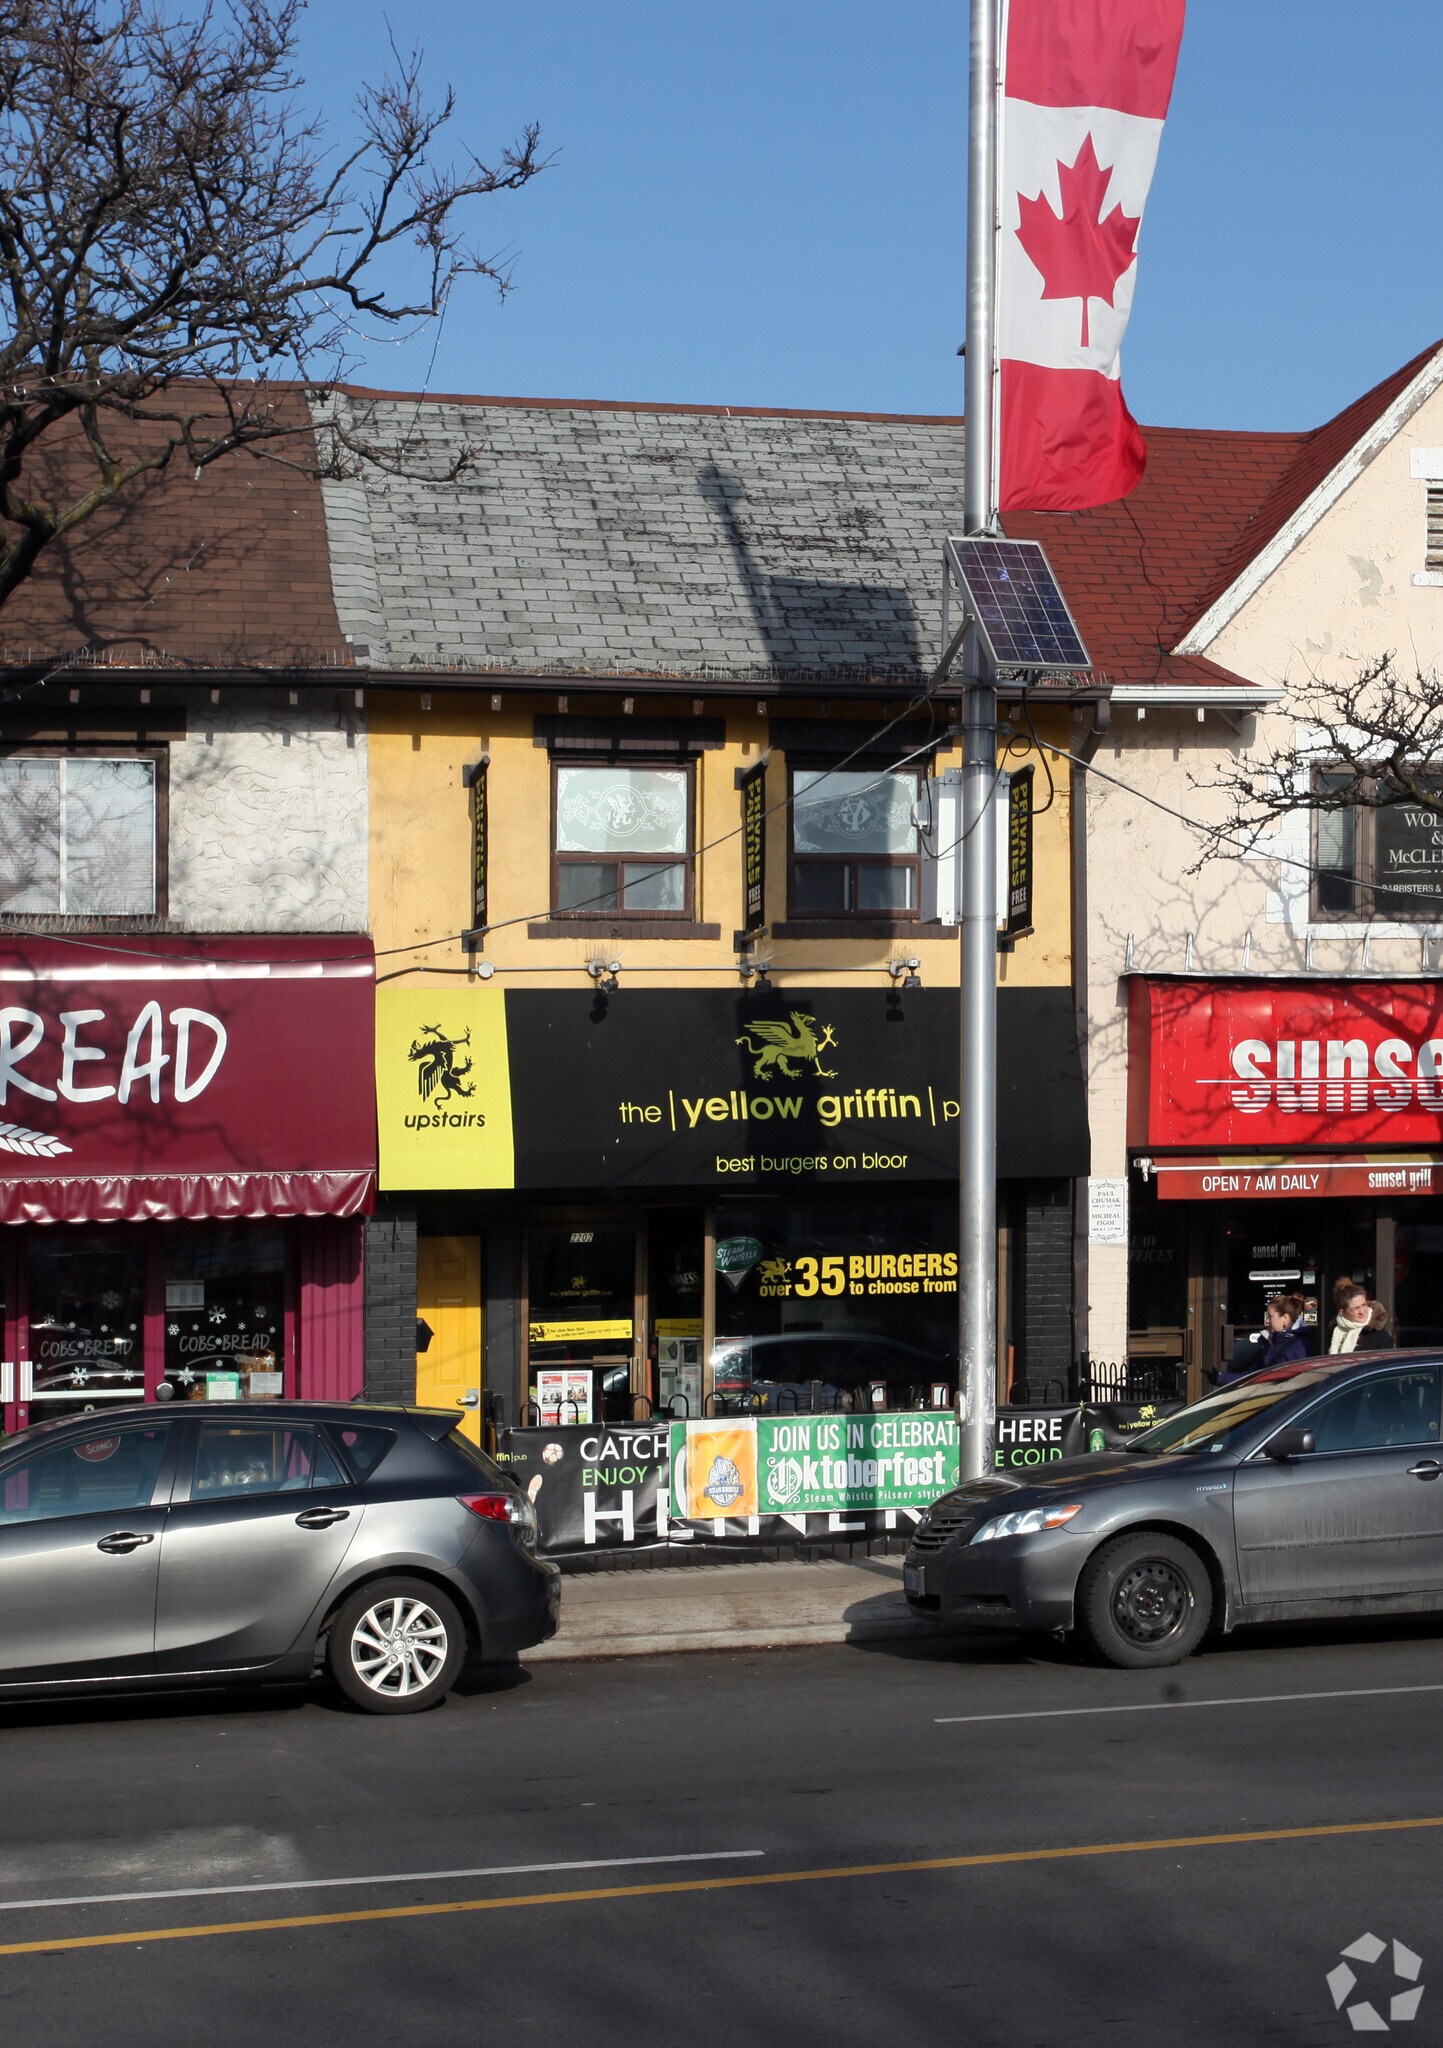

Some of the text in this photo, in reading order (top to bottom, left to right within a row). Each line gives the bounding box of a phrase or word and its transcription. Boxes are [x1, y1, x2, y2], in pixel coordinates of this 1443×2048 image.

[1404, 812, 1443, 828] WOL
[1389, 849, 1443, 864] McCLE
[1012, 887, 1027, 906] FREE
[0, 1000, 228, 1104] READ
[1231, 1038, 1443, 1114] sunse
[618, 1101, 662, 1124] the
[682, 1090, 804, 1128] yellow
[817, 1088, 922, 1127] griffin
[403, 1110, 486, 1131] upstairs
[715, 1152, 908, 1175] best burgers on bloor
[1202, 1174, 1320, 1192] OPEN 7 AM DAILY
[1368, 1168, 1432, 1192] sunset grill
[570, 1233, 594, 1243] 2202
[716, 1246, 745, 1260] STEAM
[720, 1250, 759, 1267] WHISTLE
[1129, 1249, 1175, 1263] FFICES
[1252, 1242, 1297, 1262] sunset grill
[759, 1252, 958, 1297] over 35 BURGERS
[560, 1290, 581, 1298] yellow
[581, 1288, 600, 1298] griffin
[849, 1278, 957, 1295] to choose from
[40, 1339, 133, 1357] COBS BREAD
[178, 1334, 270, 1352] COBS BREAD
[1130, 1421, 1151, 1430] yellow
[579, 1417, 1063, 1462] CATCH HERE
[769, 1420, 960, 1453] JOIN US IN CELEBRATI
[86, 1439, 113, 1455] Scones
[495, 1452, 528, 1463] ffin pub
[582, 1465, 648, 1486] ENJOY
[767, 1451, 946, 1505] Oktoberfest
[804, 1493, 834, 1503] Steam
[838, 1491, 874, 1502] Whistle
[878, 1490, 913, 1500] Pilsner
